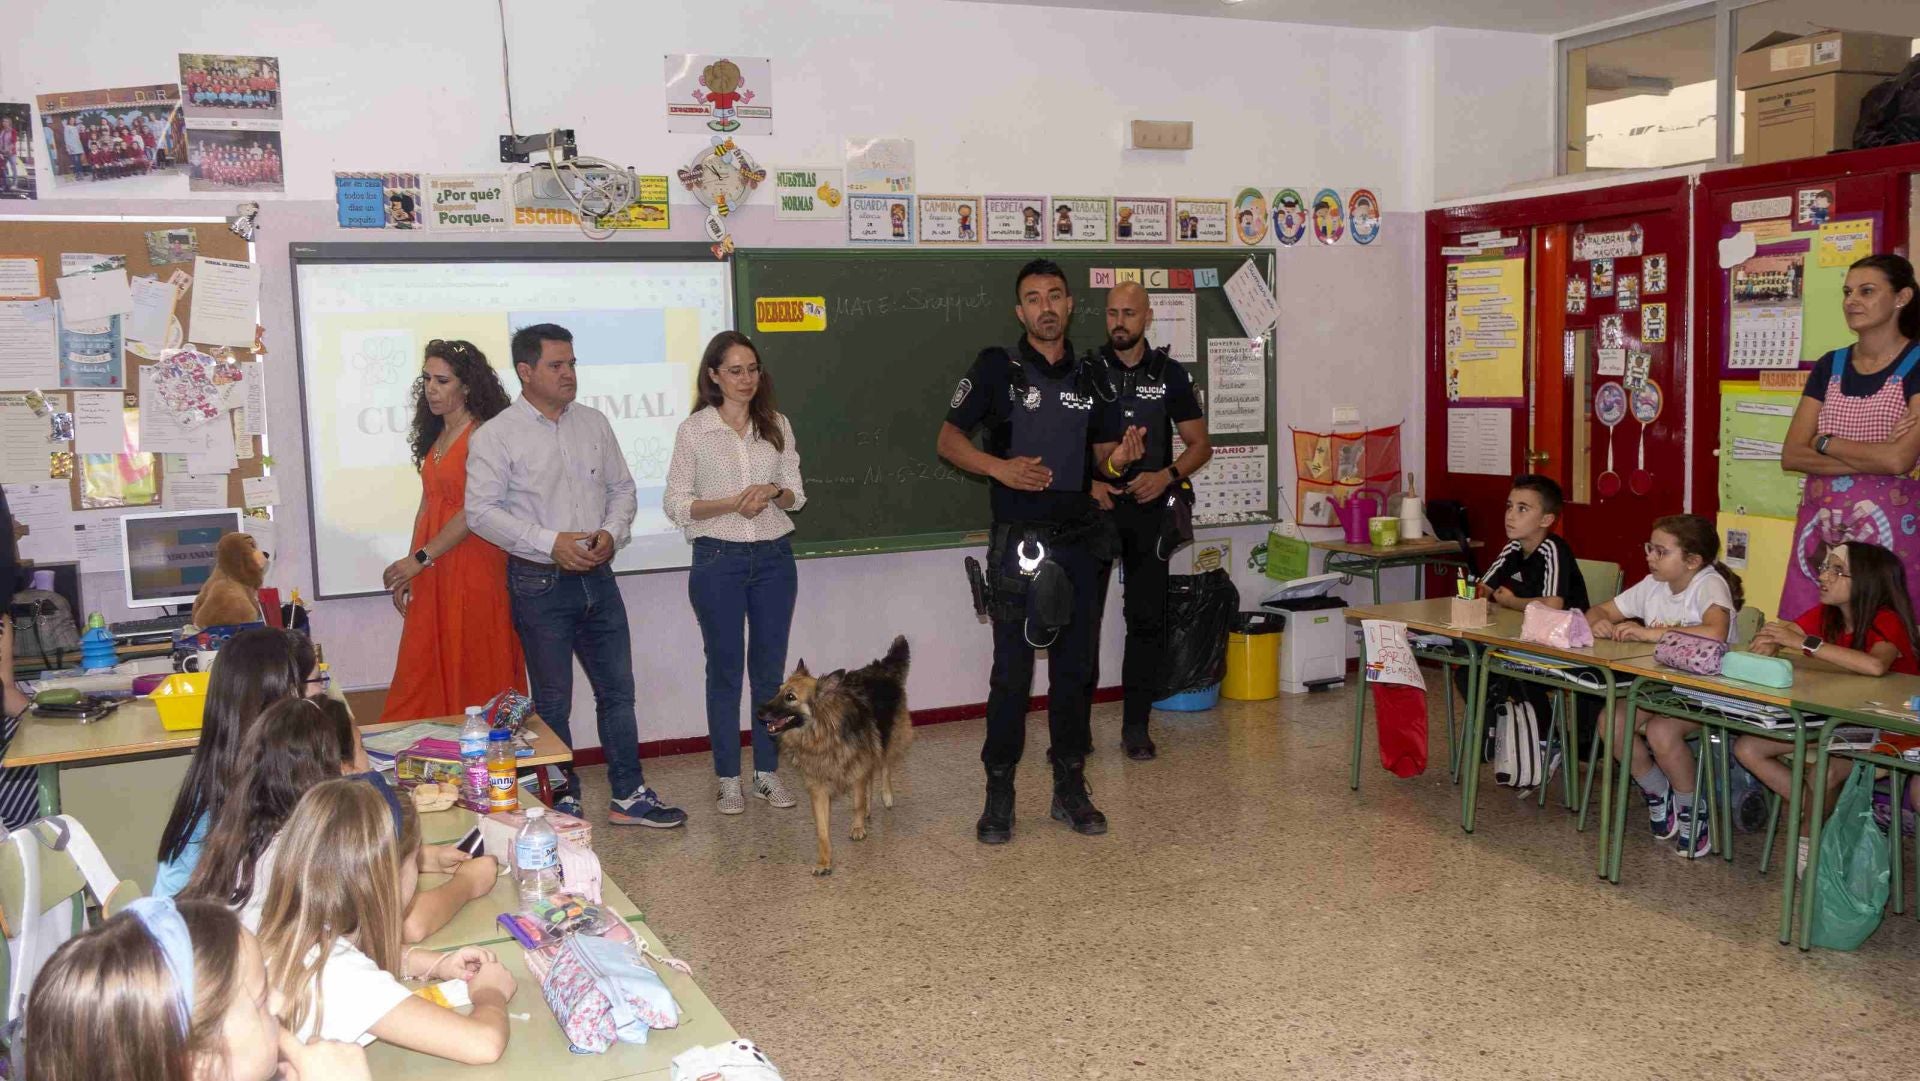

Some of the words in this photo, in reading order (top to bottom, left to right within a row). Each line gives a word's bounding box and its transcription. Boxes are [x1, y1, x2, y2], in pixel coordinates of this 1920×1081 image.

[776, 172, 816, 188] NUESTRAS
[437, 189, 466, 204] ¿Por
[470, 188, 502, 203] qué?
[782, 196, 814, 212] NORMAS
[854, 200, 888, 212] GUARDA
[924, 201, 957, 212] CAMINA
[990, 202, 1024, 213] RESPETA
[1072, 202, 1105, 213] TRABAJA
[1132, 203, 1165, 215] LEVANTA
[1190, 204, 1222, 215] ESCUCHA
[348, 216, 376, 226] poquito
[439, 212, 504, 226] Porque...
[1095, 272, 1110, 285] DM
[1150, 270, 1160, 286] C
[757, 301, 804, 323] DEBERES
[1761, 372, 1796, 387] PASAMOS
[1798, 373, 1808, 387] LI
[358, 406, 409, 435] CU
[1212, 446, 1246, 455] RARIO
